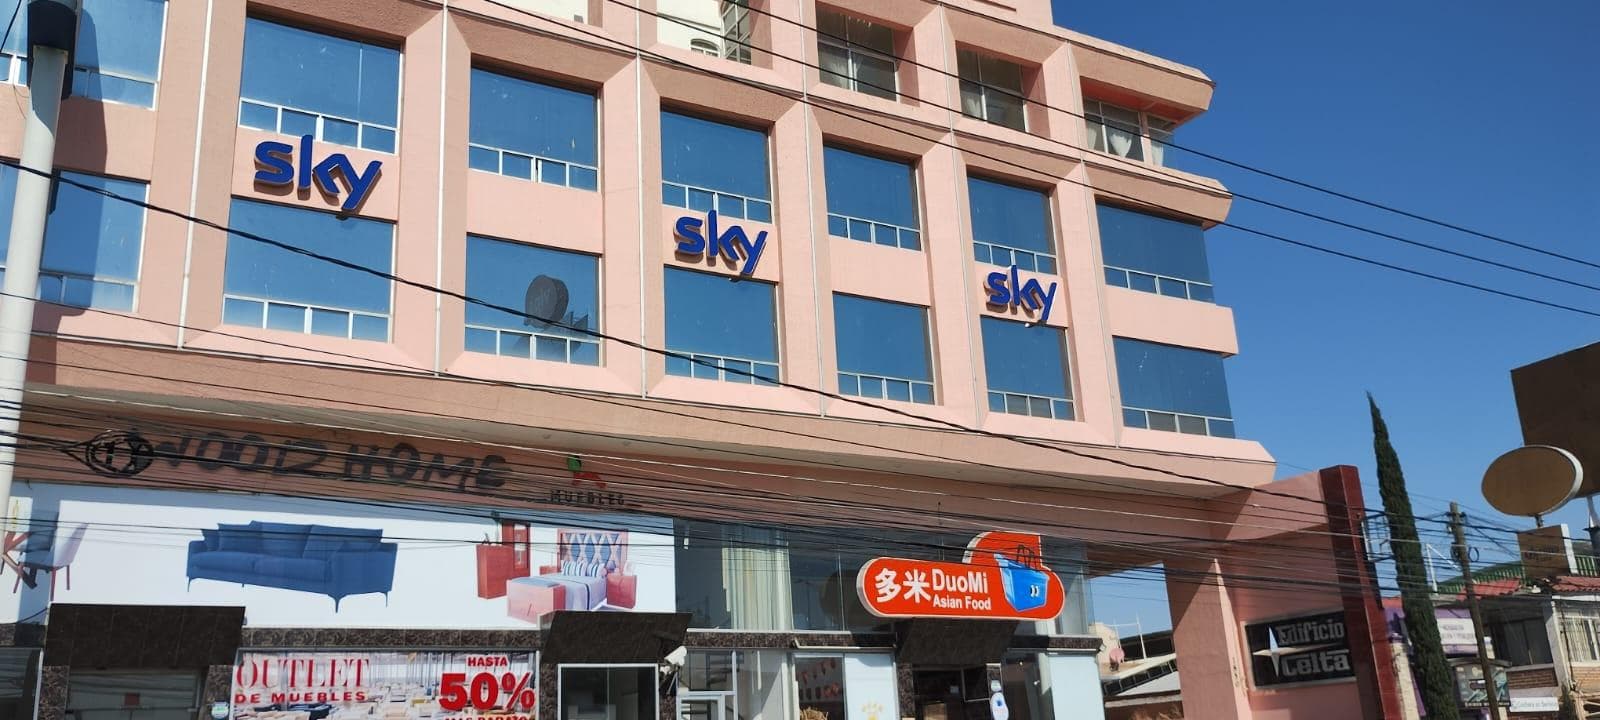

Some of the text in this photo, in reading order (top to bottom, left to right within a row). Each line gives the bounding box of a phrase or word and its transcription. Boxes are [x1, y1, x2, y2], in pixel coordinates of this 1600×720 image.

[253, 134, 383, 210] sky
[675, 209, 769, 274] sky
[986, 264, 1058, 323] sky
[344, 442, 512, 493] HOME
[874, 567, 931, 604] 多米
[931, 568, 989, 594] DuoMi
[932, 596, 992, 611] Asian Food
[1276, 619, 1345, 646] Edificio
[236, 655, 370, 688] OUTLET
[467, 656, 508, 667] HASTA
[1281, 649, 1350, 677] Celta
[234, 691, 366, 704] DE MUEBLES
[438, 671, 535, 712] 50%
